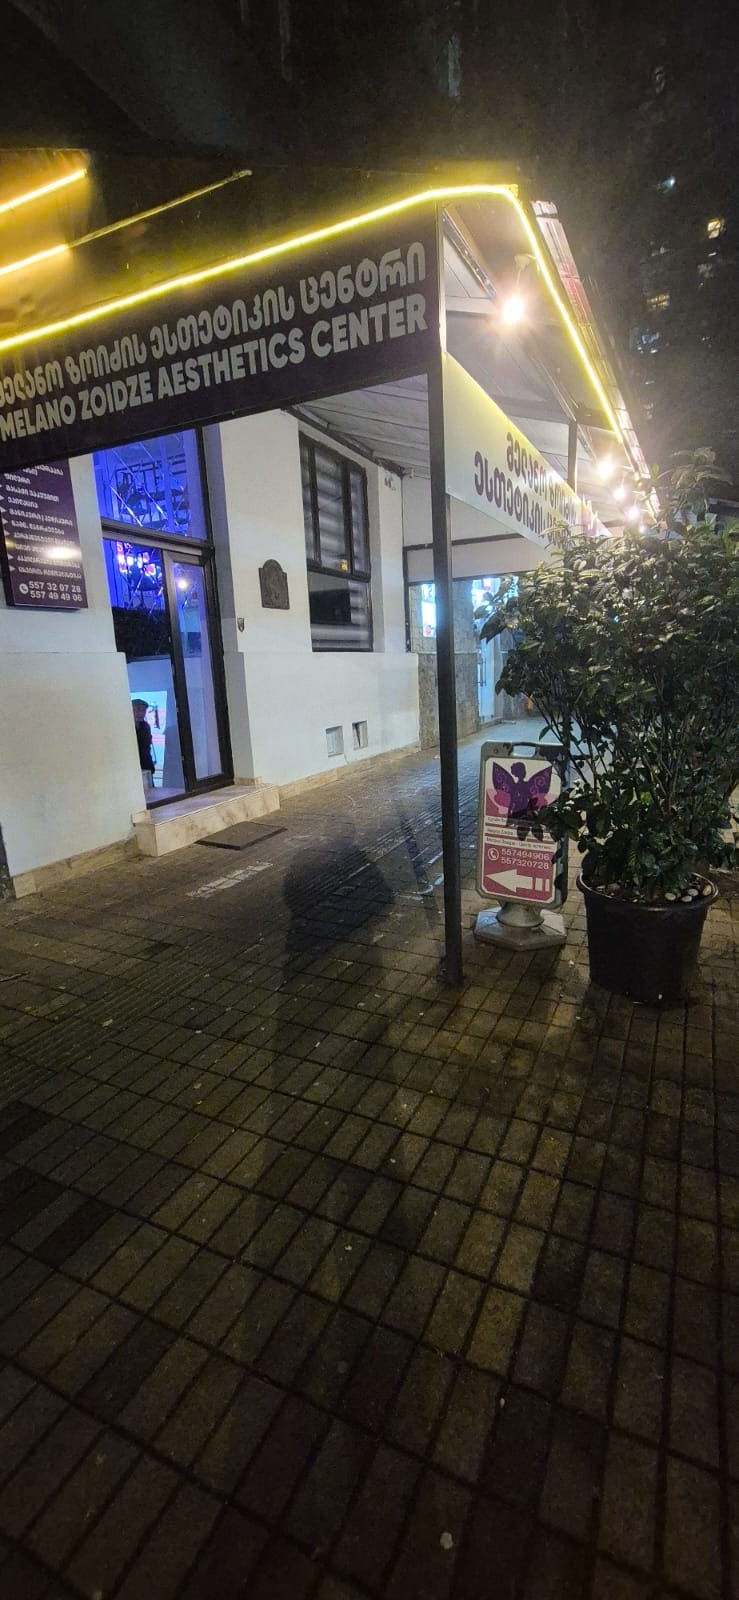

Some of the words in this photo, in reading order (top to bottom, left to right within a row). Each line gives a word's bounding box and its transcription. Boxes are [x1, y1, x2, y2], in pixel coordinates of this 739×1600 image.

[65, 334, 147, 385] ზოიძის
[150, 286, 296, 360] ესთეტიკის
[300, 241, 426, 315] ცენტრი
[0, 395, 76, 441] MELANO
[78, 371, 154, 420] ZOIDZE
[157, 328, 306, 400] AESTHETICS
[311, 293, 428, 358] CENTER
[28, 580, 45, 590] 557
[46, 582, 58, 592] 32
[59, 583, 70, 592] 07
[29, 590, 46, 599] 557
[48, 592, 59, 600] 49
